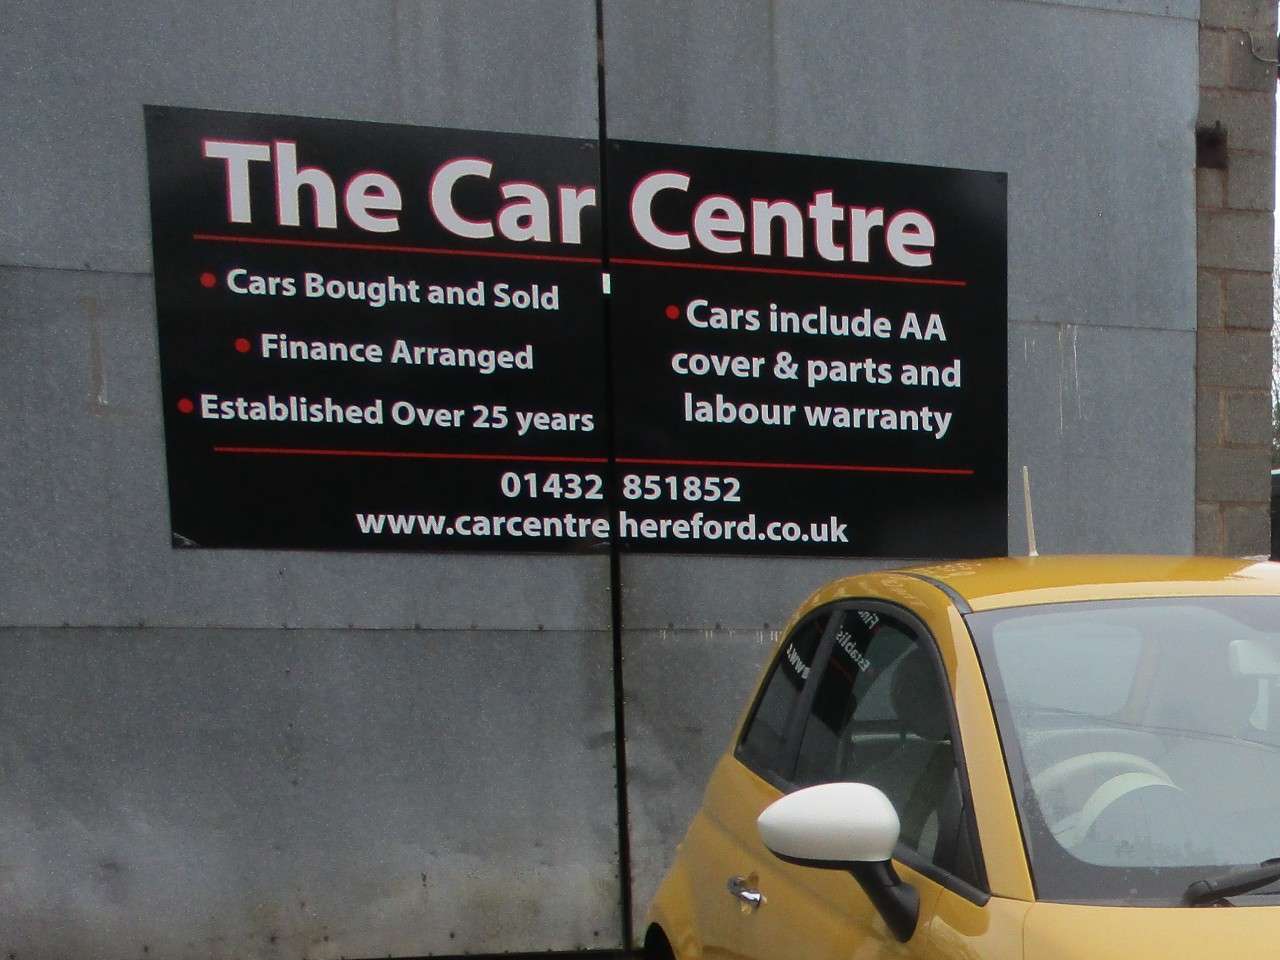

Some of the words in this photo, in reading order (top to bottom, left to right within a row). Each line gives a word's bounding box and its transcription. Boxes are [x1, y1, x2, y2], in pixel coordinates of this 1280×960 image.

[203, 139, 403, 233] The
[429, 157, 598, 246] Car
[630, 171, 937, 268] Centre
[226, 268, 298, 298] Cars
[304, 272, 421, 308] Bought
[427, 280, 486, 307] and
[493, 282, 560, 311] Sold
[686, 299, 761, 332] Cars
[769, 302, 893, 339] include
[899, 311, 948, 342] AA
[261, 332, 384, 364] Finance
[390, 339, 535, 375] Arranged
[671, 353, 767, 379] cover
[773, 351, 800, 380] &
[807, 358, 894, 388] parts
[900, 359, 962, 389] and
[200, 393, 385, 425] Established
[391, 400, 466, 428] Over
[472, 404, 510, 430] 25
[515, 411, 596, 437] years
[684, 391, 797, 427] labour
[803, 405, 954, 440] warranty
[500, 471, 605, 500] 01432
[622, 474, 742, 503] 851852
